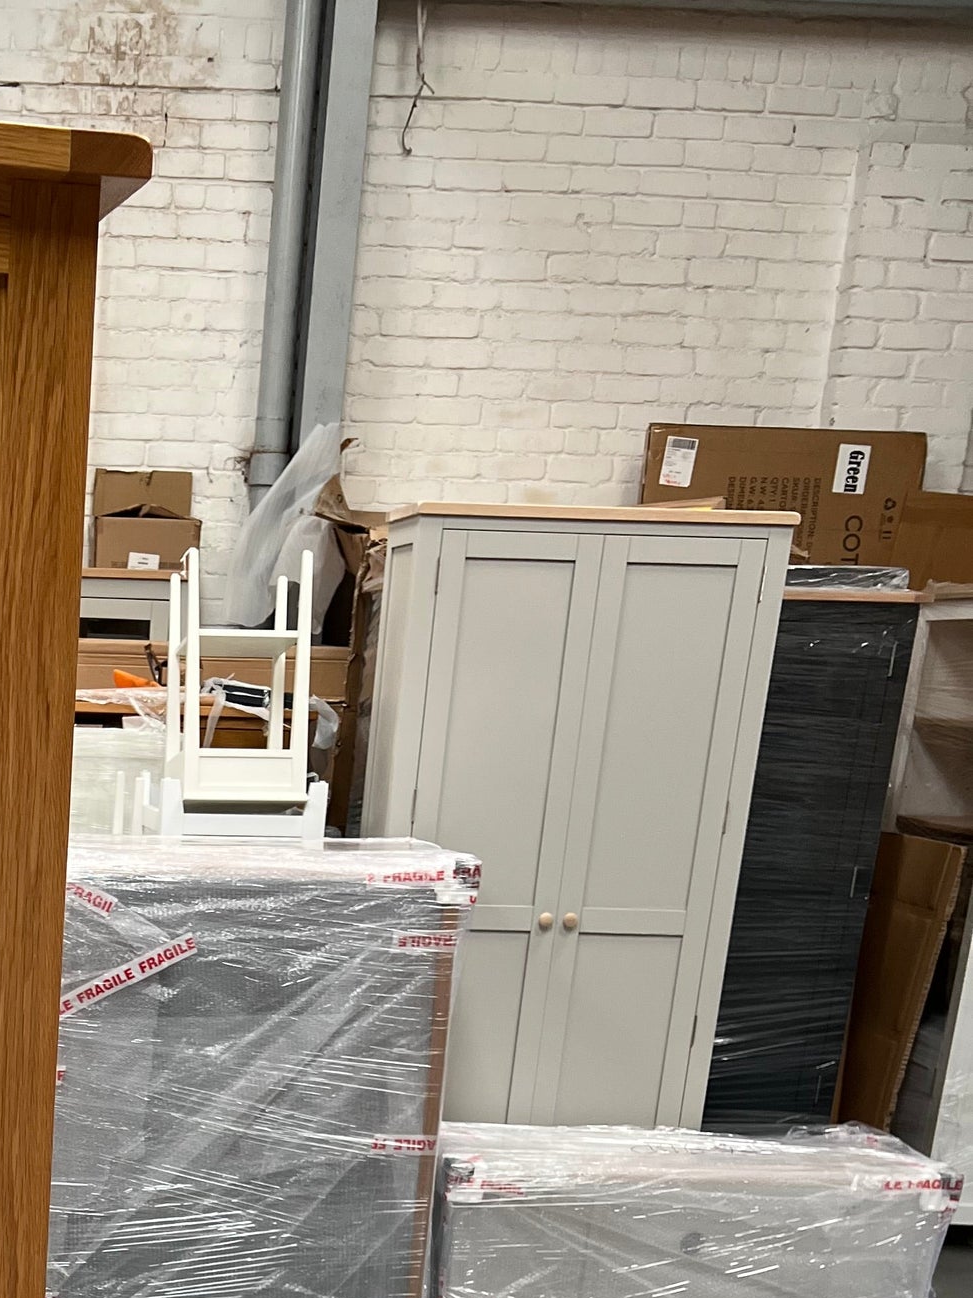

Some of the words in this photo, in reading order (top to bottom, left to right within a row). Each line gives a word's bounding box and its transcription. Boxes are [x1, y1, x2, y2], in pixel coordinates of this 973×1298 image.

[844, 450, 865, 492] Green
[737, 476, 746, 509] DIMEN
[779, 477, 789, 509] CARTO
[840, 515, 863, 565] COT
[75, 968, 136, 1004] FRAGILE
[138, 937, 197, 974] FRAGILE
